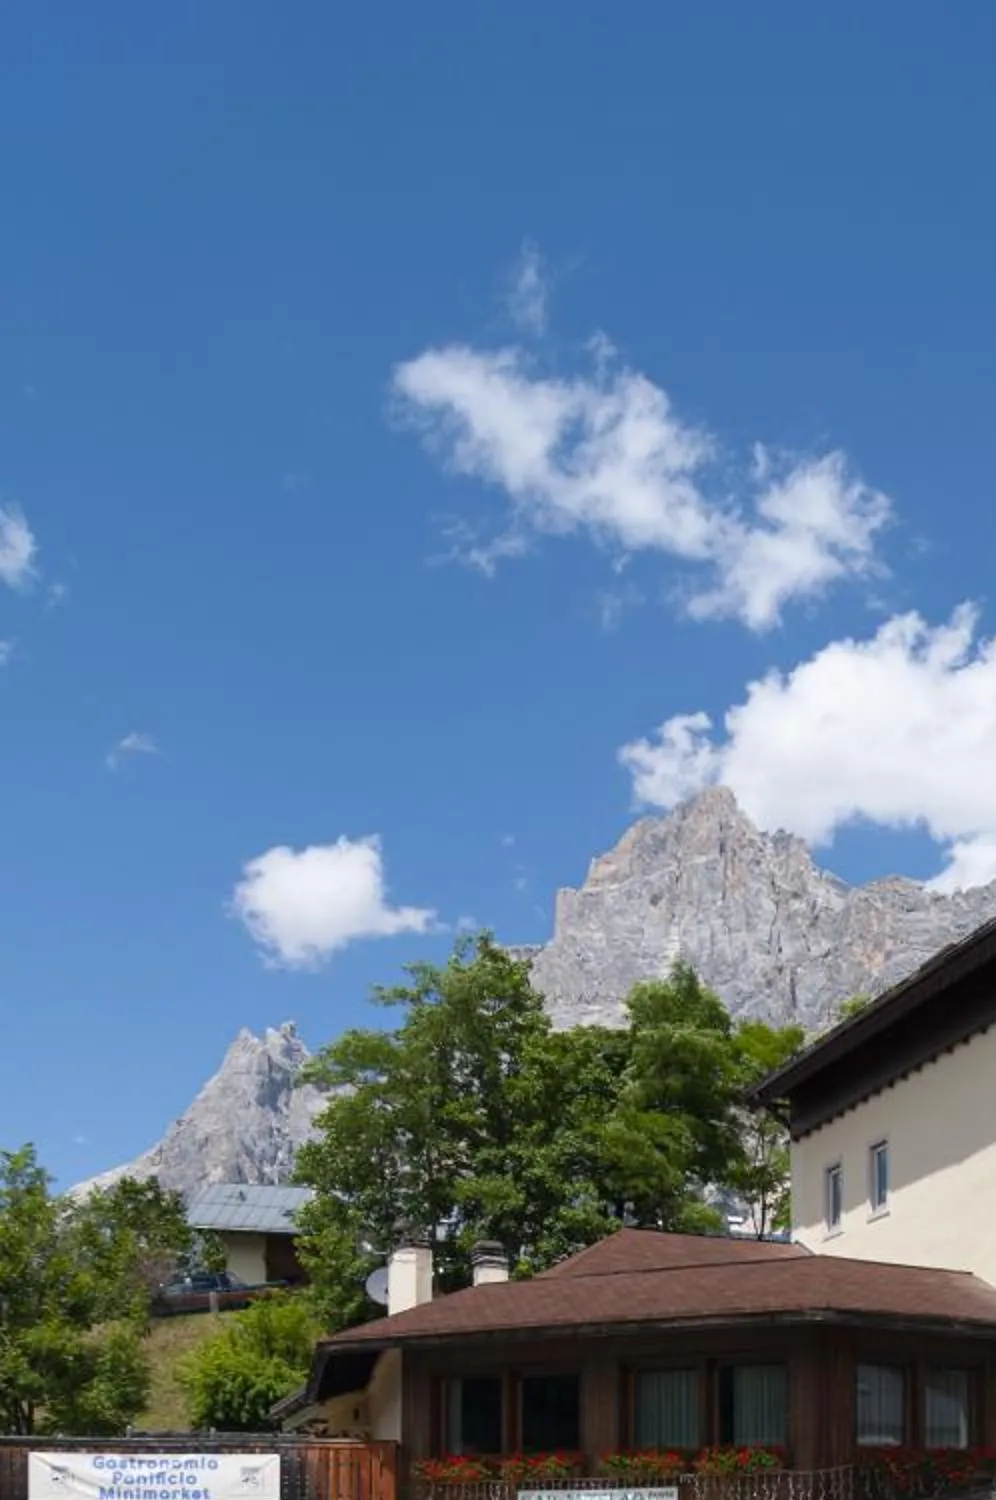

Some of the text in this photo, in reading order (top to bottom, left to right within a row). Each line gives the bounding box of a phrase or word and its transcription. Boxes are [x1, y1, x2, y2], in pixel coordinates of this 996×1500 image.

[92, 1455, 219, 1470] Gastronomia
[112, 1471, 197, 1485] Panificio
[99, 1486, 211, 1500] Minimarket
